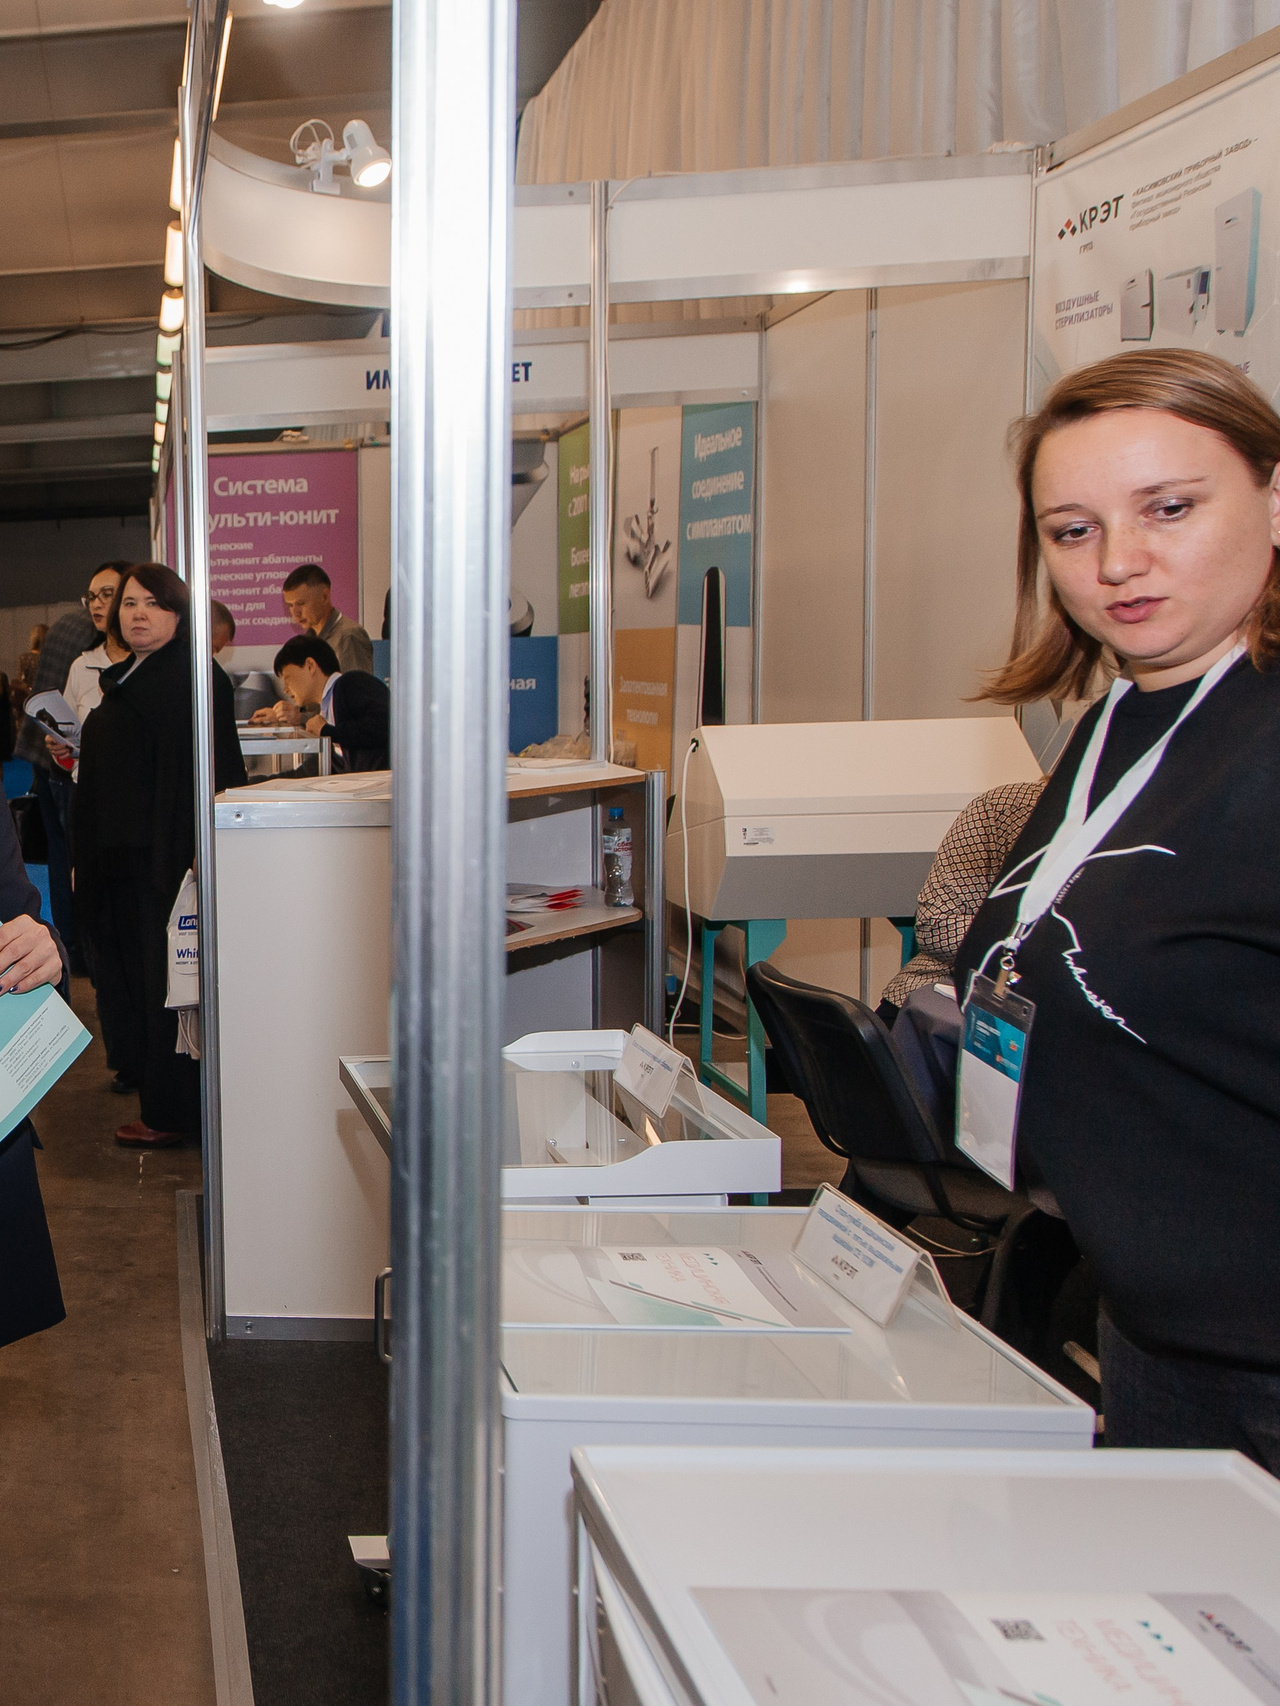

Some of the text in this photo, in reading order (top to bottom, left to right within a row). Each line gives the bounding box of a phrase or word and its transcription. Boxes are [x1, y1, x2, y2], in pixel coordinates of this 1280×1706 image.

[1079, 194, 1124, 233] КРЭТ
[1055, 289, 1100, 314] ВОЗДУШНЫЕ
[1055, 301, 1114, 330] СТЕРИЛИЗАТОРЫ
[512, 361, 533, 382] ЕТ
[694, 425, 743, 462] Идеальное
[213, 475, 309, 497] Система
[692, 469, 745, 503] соединение
[208, 508, 339, 534] ульти-юнит
[209, 541, 254, 551] ические
[210, 553, 323, 567] ьти-юнит абатменты
[209, 571, 254, 582] ические
[210, 584, 283, 597] ьти-юнит аба
[225, 601, 266, 612] ны для
[234, 617, 251, 626] ых
